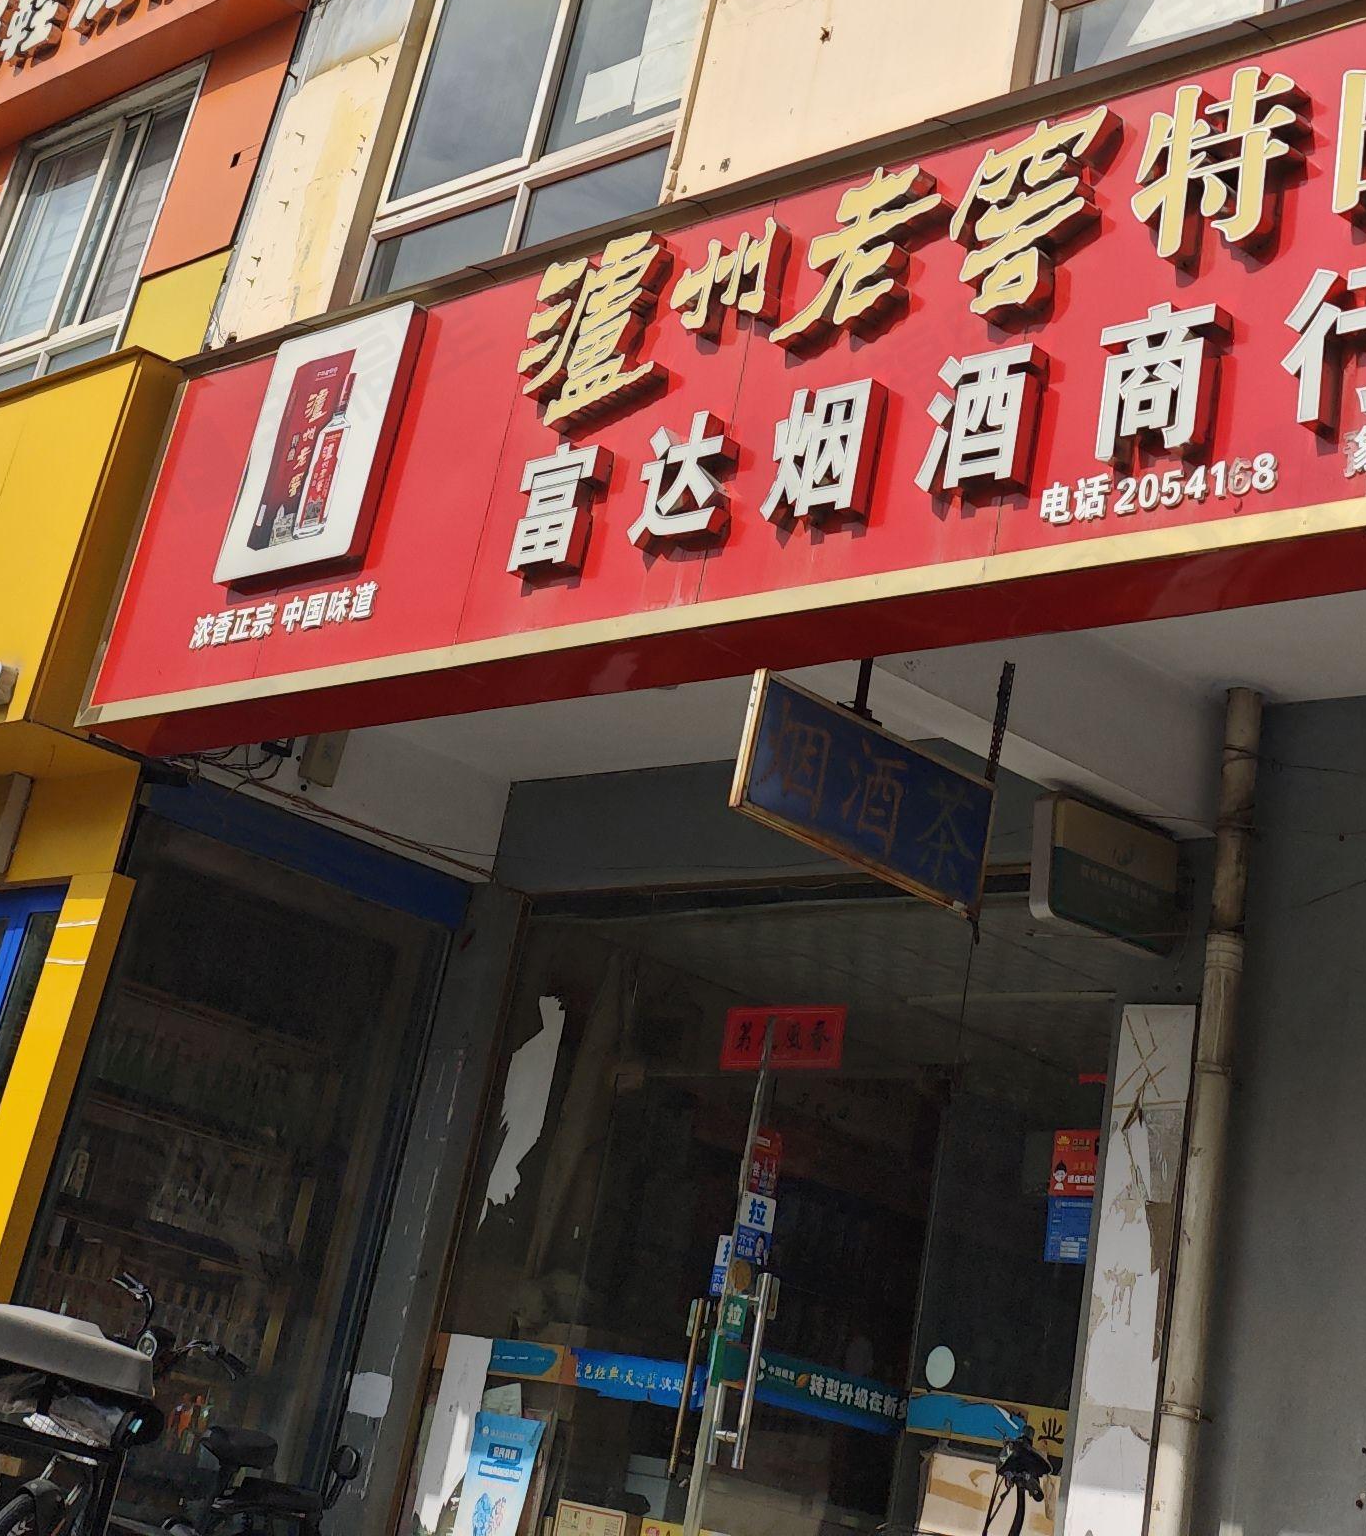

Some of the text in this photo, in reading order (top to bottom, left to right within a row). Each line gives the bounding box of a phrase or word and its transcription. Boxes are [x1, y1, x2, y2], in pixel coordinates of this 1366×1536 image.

[188, 580, 379, 651] 浓香正宗 中国味道
[748, 1197, 768, 1227] 拉
